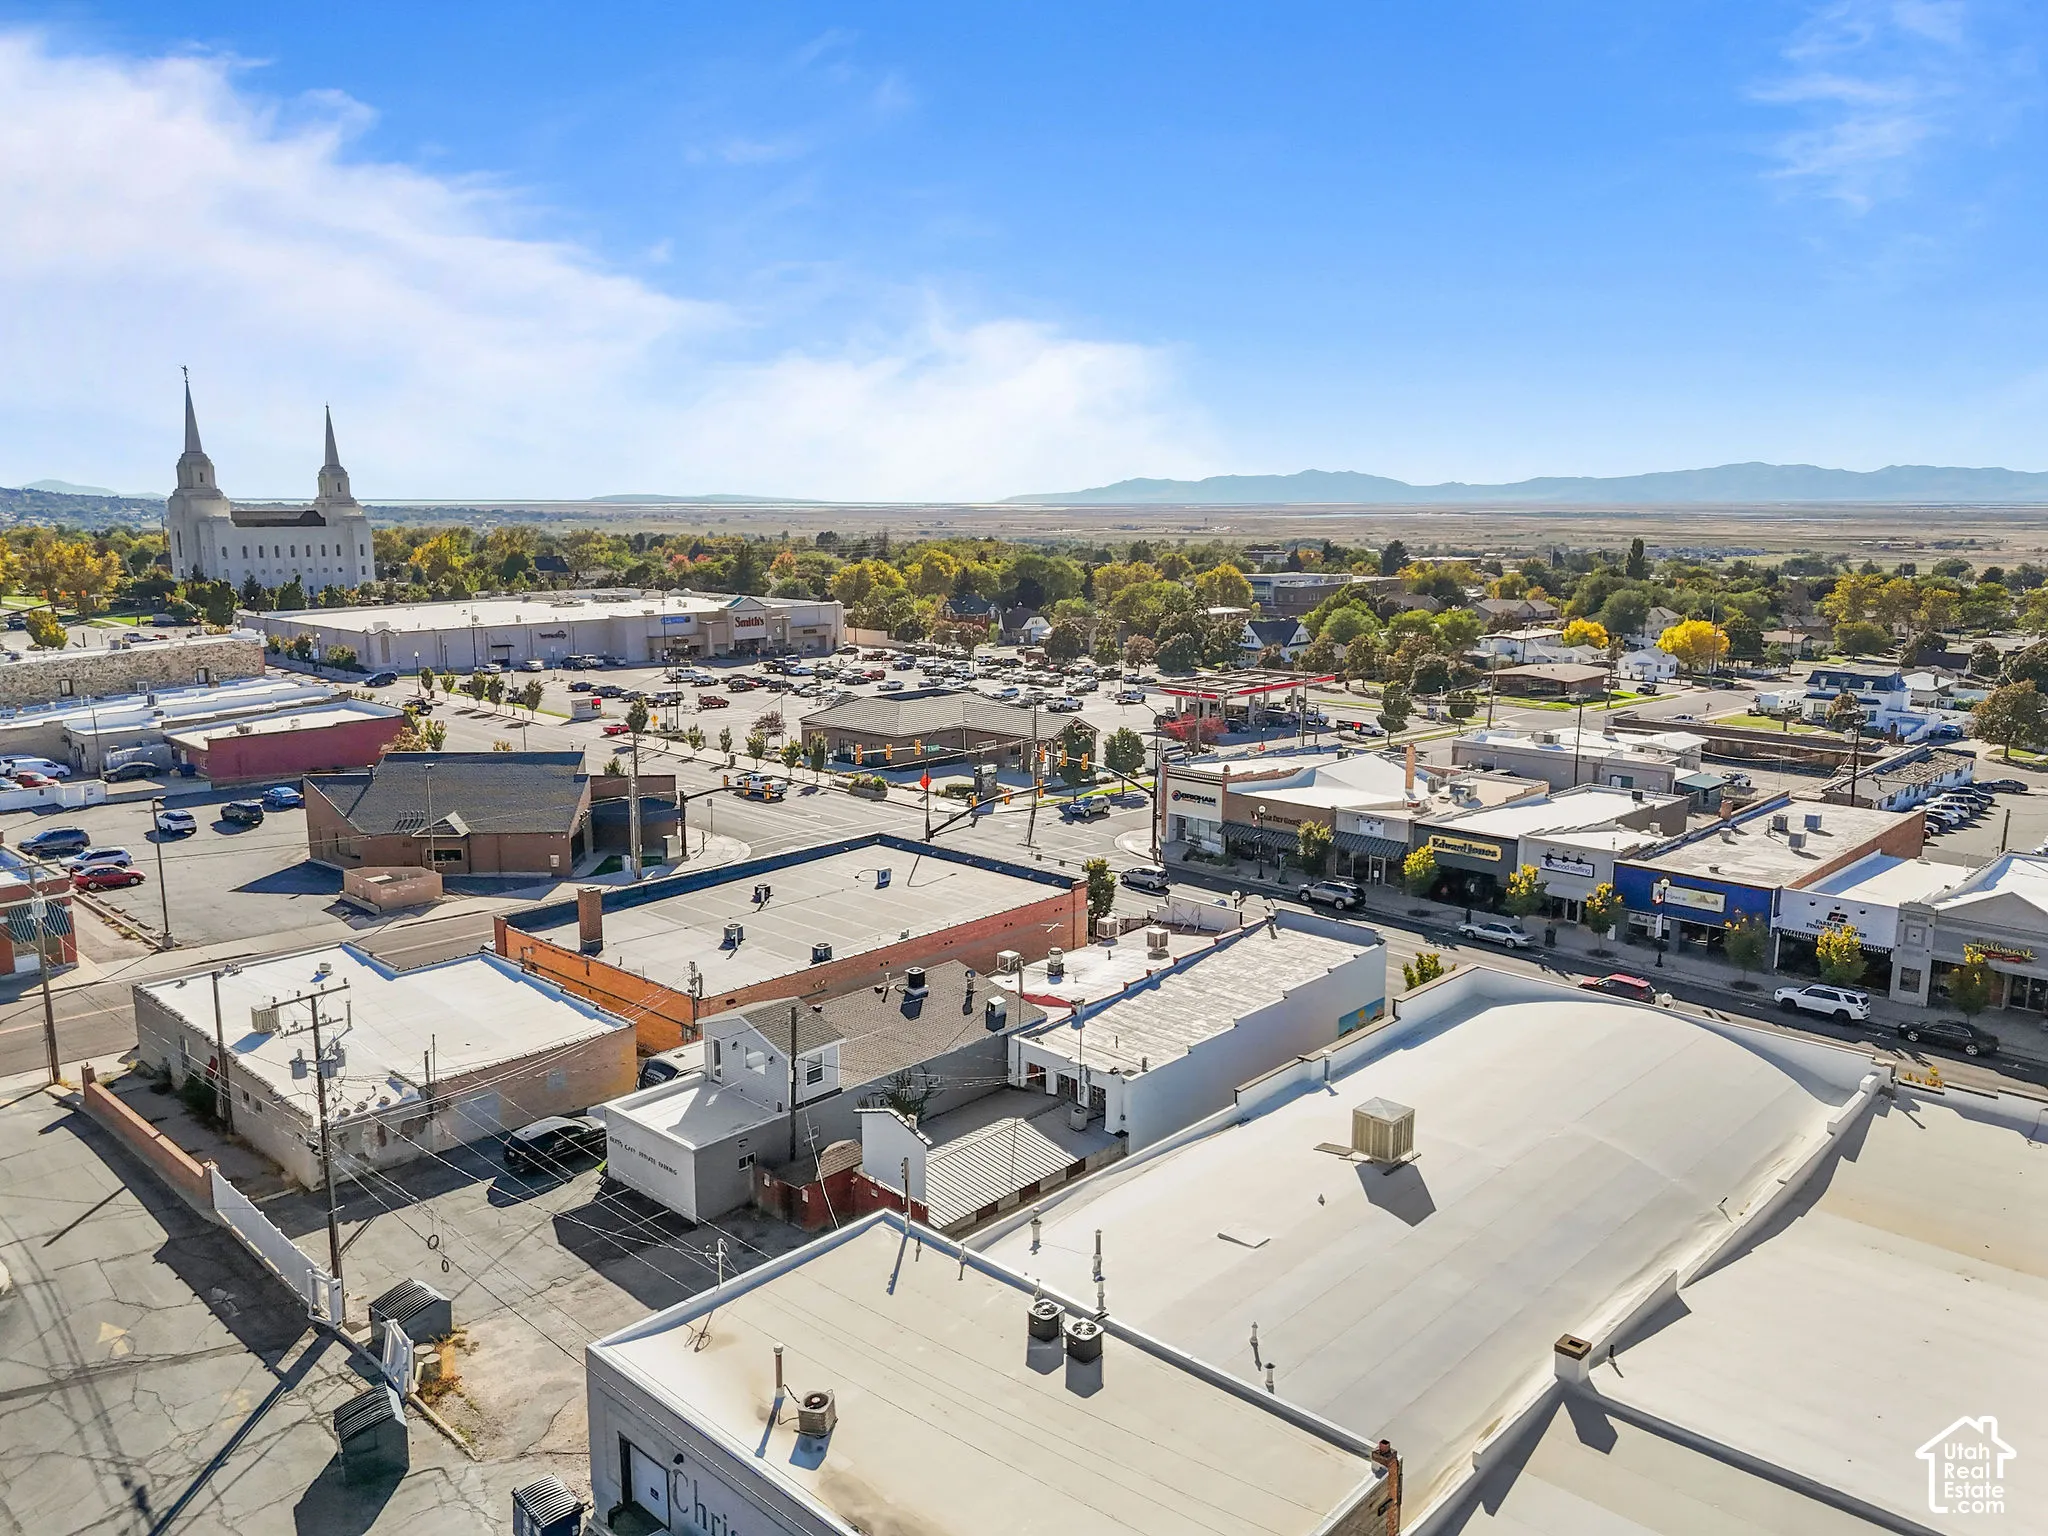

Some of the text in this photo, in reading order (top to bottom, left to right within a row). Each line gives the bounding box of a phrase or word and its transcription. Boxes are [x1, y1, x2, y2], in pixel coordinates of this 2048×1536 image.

[735, 616, 764, 628] Smith's
[1432, 838, 1497, 857] Edward Jones
[1969, 941, 2039, 960] Hallmark
